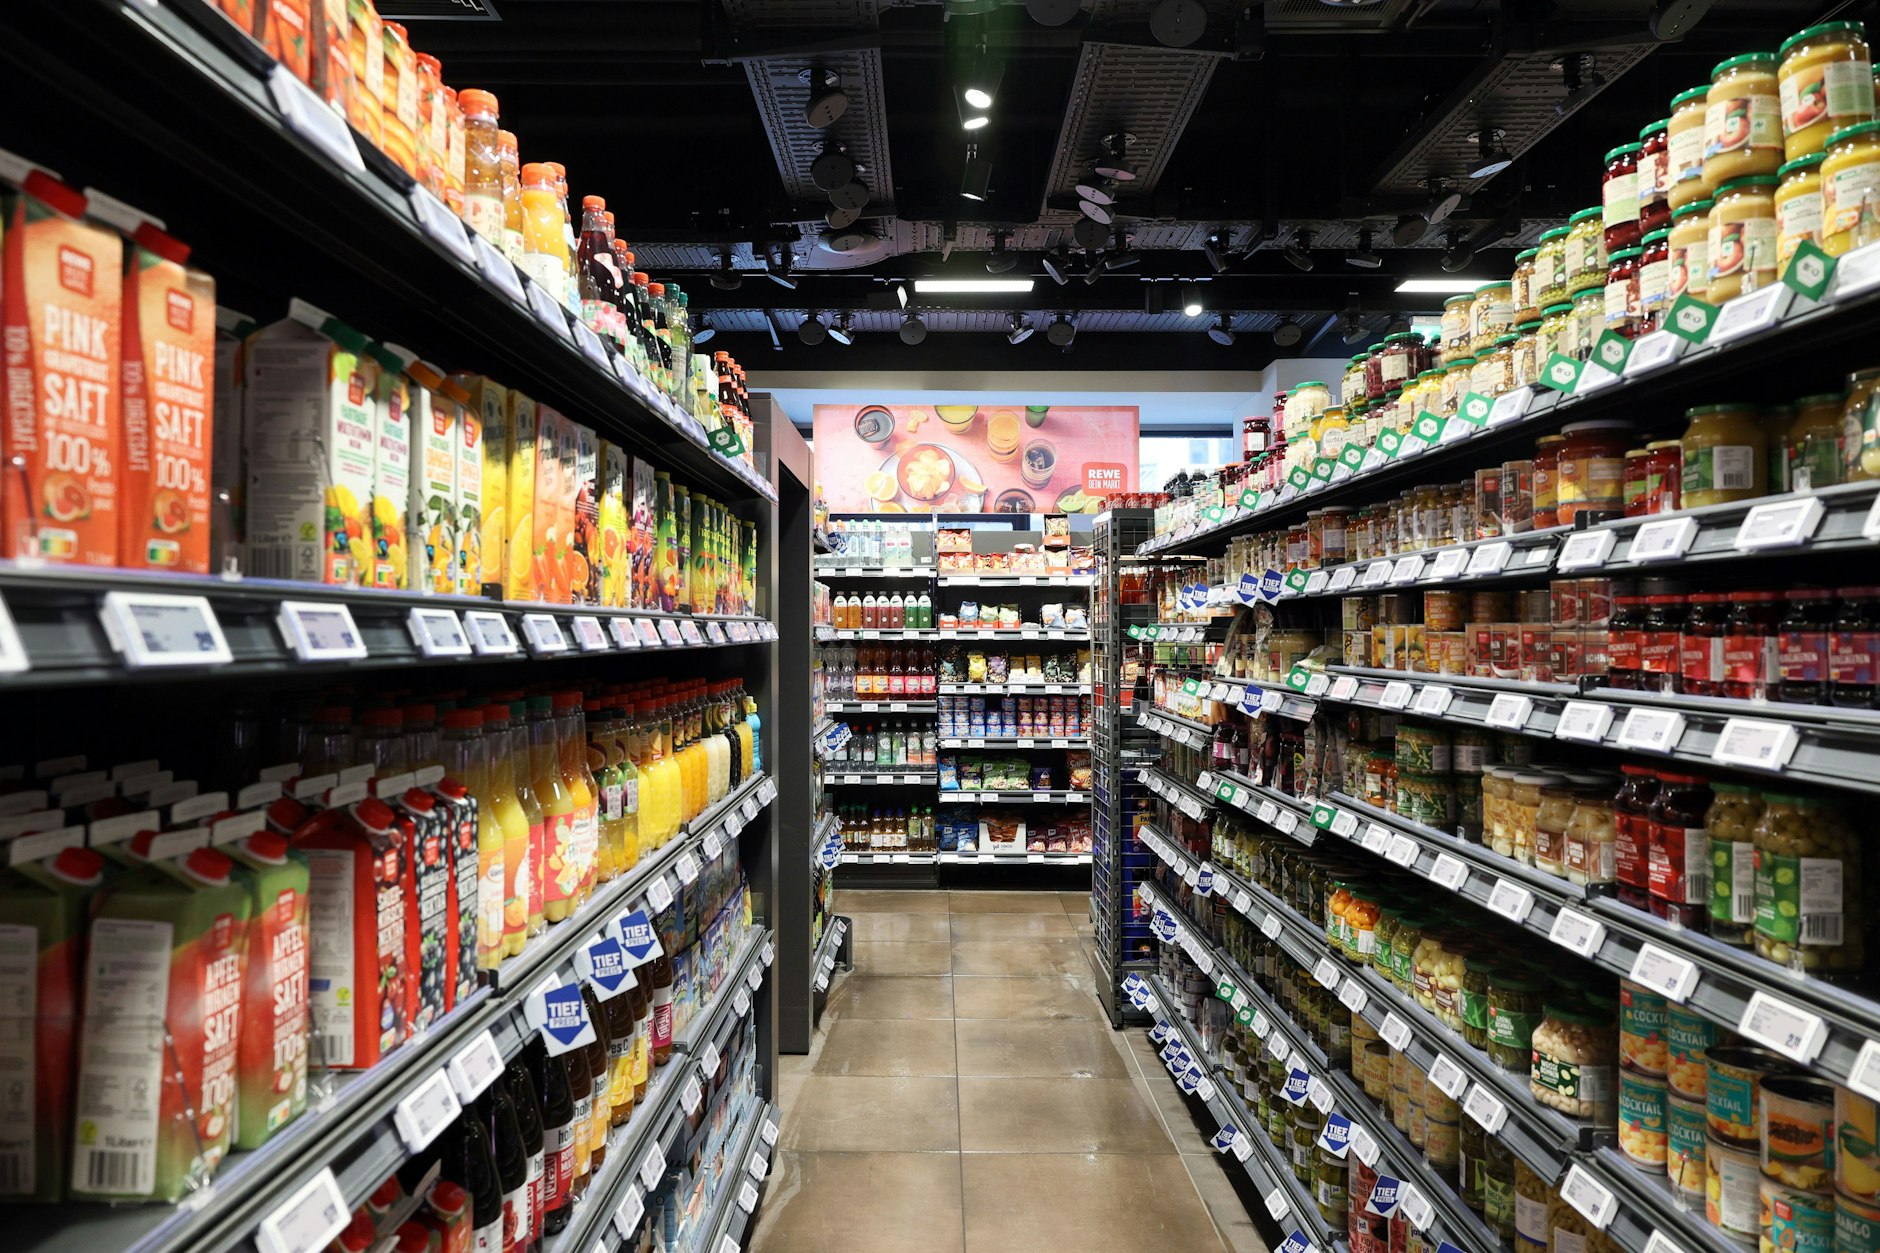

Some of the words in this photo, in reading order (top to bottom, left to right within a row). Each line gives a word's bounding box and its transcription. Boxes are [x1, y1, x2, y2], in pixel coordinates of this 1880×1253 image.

[1803, 262, 1819, 277] BIO
[1683, 312, 1701, 324] BIO
[44, 304, 107, 361] PINK
[1606, 345, 1620, 356] BIO
[155, 340, 205, 390] PINK
[44, 373, 109, 426] SAFT
[155, 402, 205, 449] SAFT
[1424, 422, 1435, 431] BIO
[1349, 452, 1359, 460] BIO
[1088, 469, 1120, 479] REWE
[1088, 480, 1101, 489] DEIN
[1103, 480, 1120, 489] MARKT
[1242, 583, 1257, 592] TIEF
[1264, 577, 1280, 587] TIEF
[1195, 590, 1208, 598] TIEF
[1246, 692, 1261, 702] TIEF
[1201, 876, 1212, 884] TIEF
[623, 924, 648, 939] TIEF
[272, 925, 304, 961] APFEL
[627, 937, 649, 946] PREIS
[272, 946, 304, 985] BIRNEN
[593, 952, 621, 968] TIEF
[204, 954, 240, 993] APFEL
[598, 966, 621, 977] PREIS
[203, 979, 240, 1016] BIRNEN
[273, 969, 304, 1016] SAFT
[548, 1001, 580, 1019] TIEF
[203, 1003, 239, 1053] SAFT
[551, 1017, 579, 1028] PREIS
[1290, 1078, 1307, 1089] TIEF
[1621, 1094, 1663, 1116] COCKTAIL
[1329, 1123, 1348, 1138] TIEF
[1377, 1187, 1397, 1197] TIEF
[1287, 1239, 1305, 1251] TIEF
